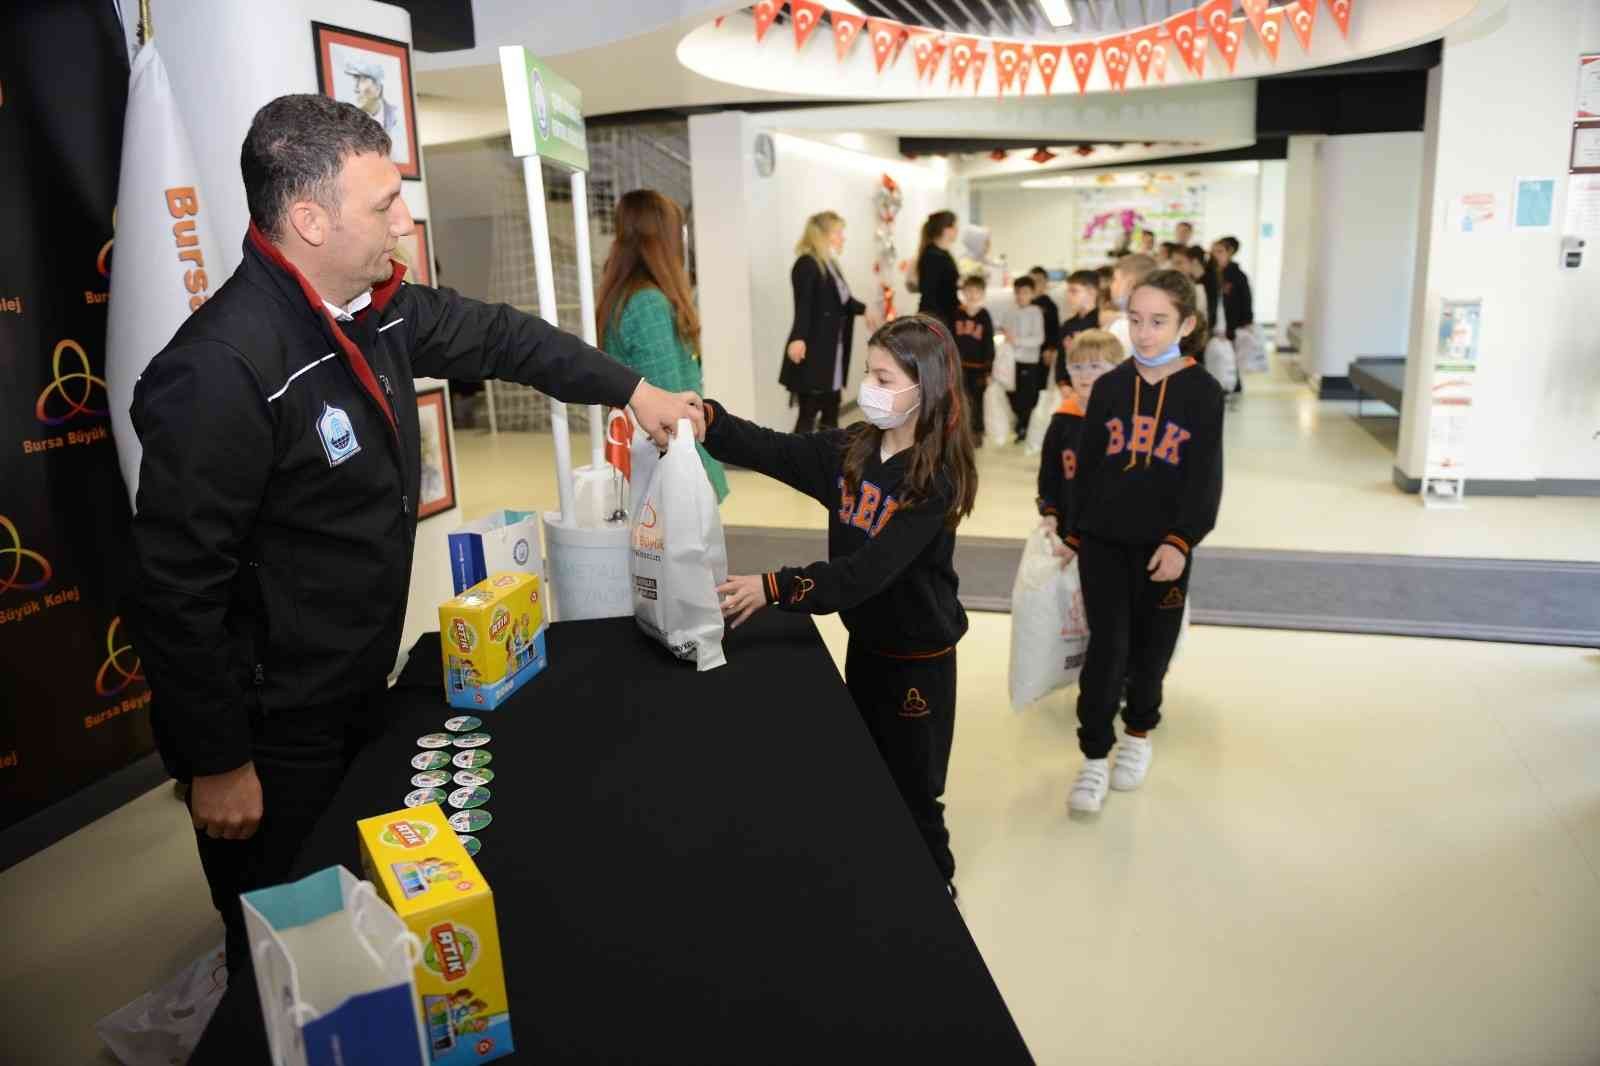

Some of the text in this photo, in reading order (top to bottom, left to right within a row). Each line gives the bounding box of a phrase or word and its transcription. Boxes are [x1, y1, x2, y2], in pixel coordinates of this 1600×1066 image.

[0, 296, 22, 314] lej
[84, 290, 111, 304] Bur
[23, 427, 108, 454] Bursa Büyük
[1105, 416, 1190, 464] BBK
[43, 586, 80, 608] Kolej
[84, 705, 120, 728] Bursa
